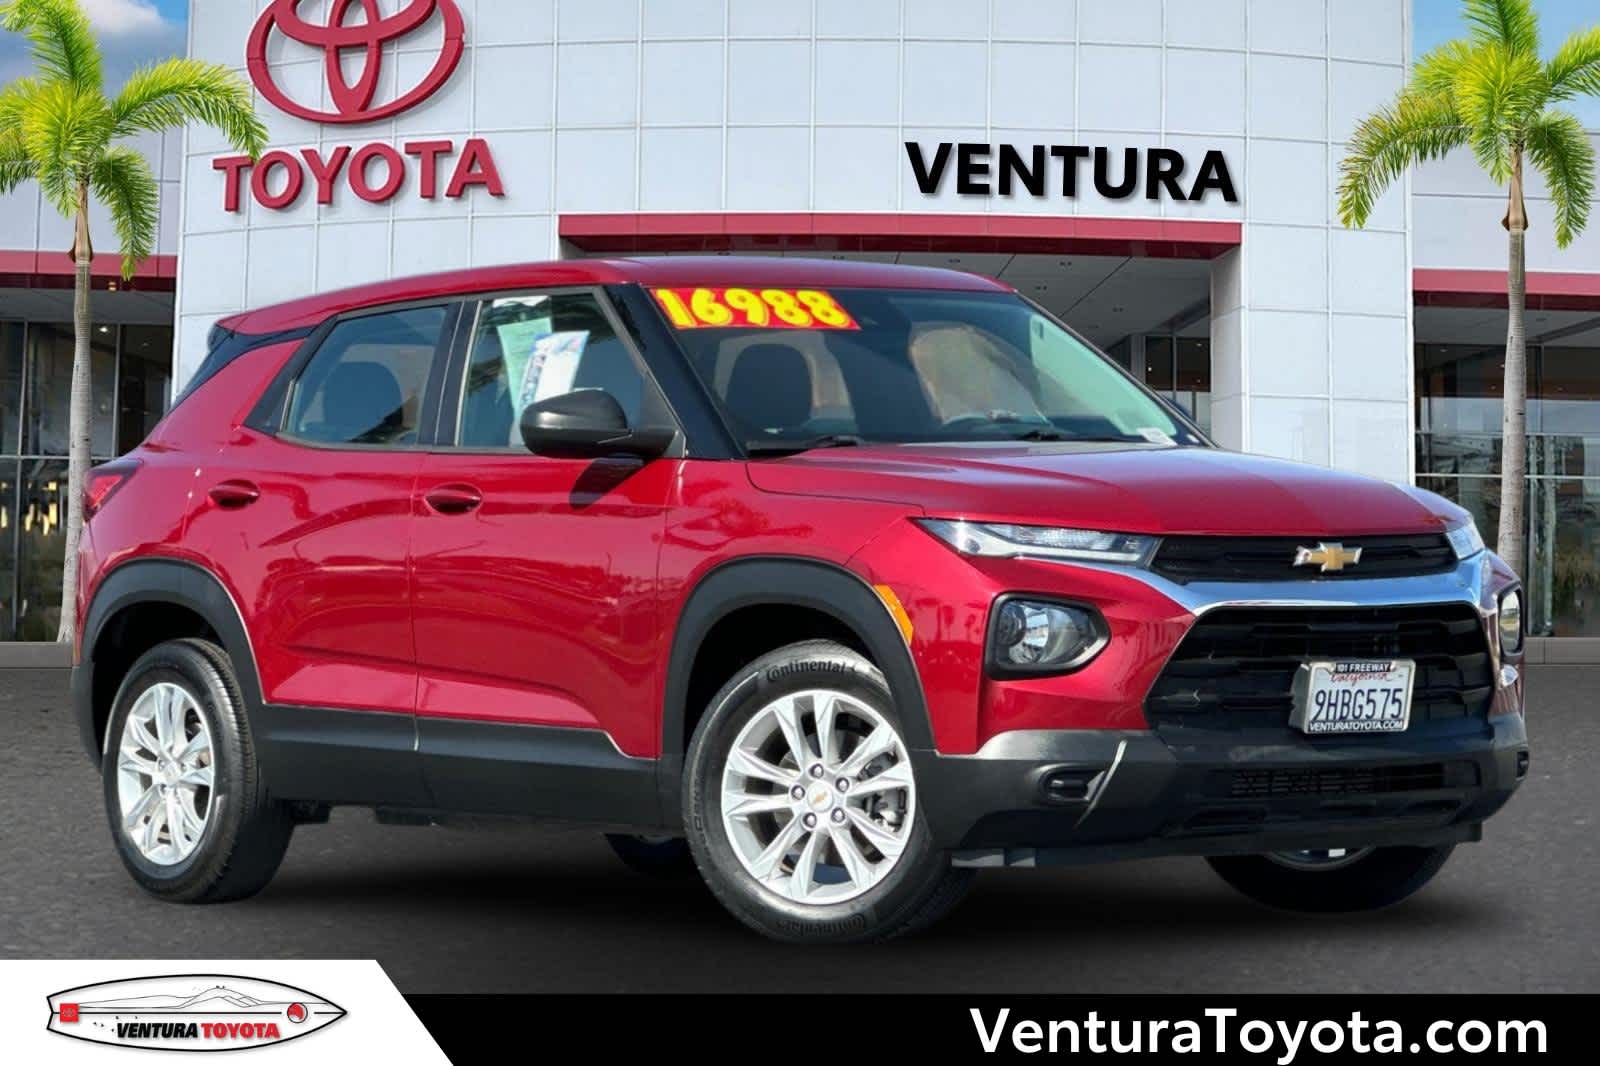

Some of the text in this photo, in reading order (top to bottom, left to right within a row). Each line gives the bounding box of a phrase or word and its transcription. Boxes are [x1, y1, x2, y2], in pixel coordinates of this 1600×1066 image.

[212, 138, 505, 211] TOYOTA
[904, 141, 1238, 203] VENTURA
[656, 287, 850, 328] 16988
[766, 659, 847, 681] Continental
[1331, 672, 1389, 686] California
[1337, 663, 1389, 672] 101 FREEWAY
[1313, 688, 1404, 721] 9HBG575
[1310, 720, 1403, 732] VENTURATOYOTA.COM
